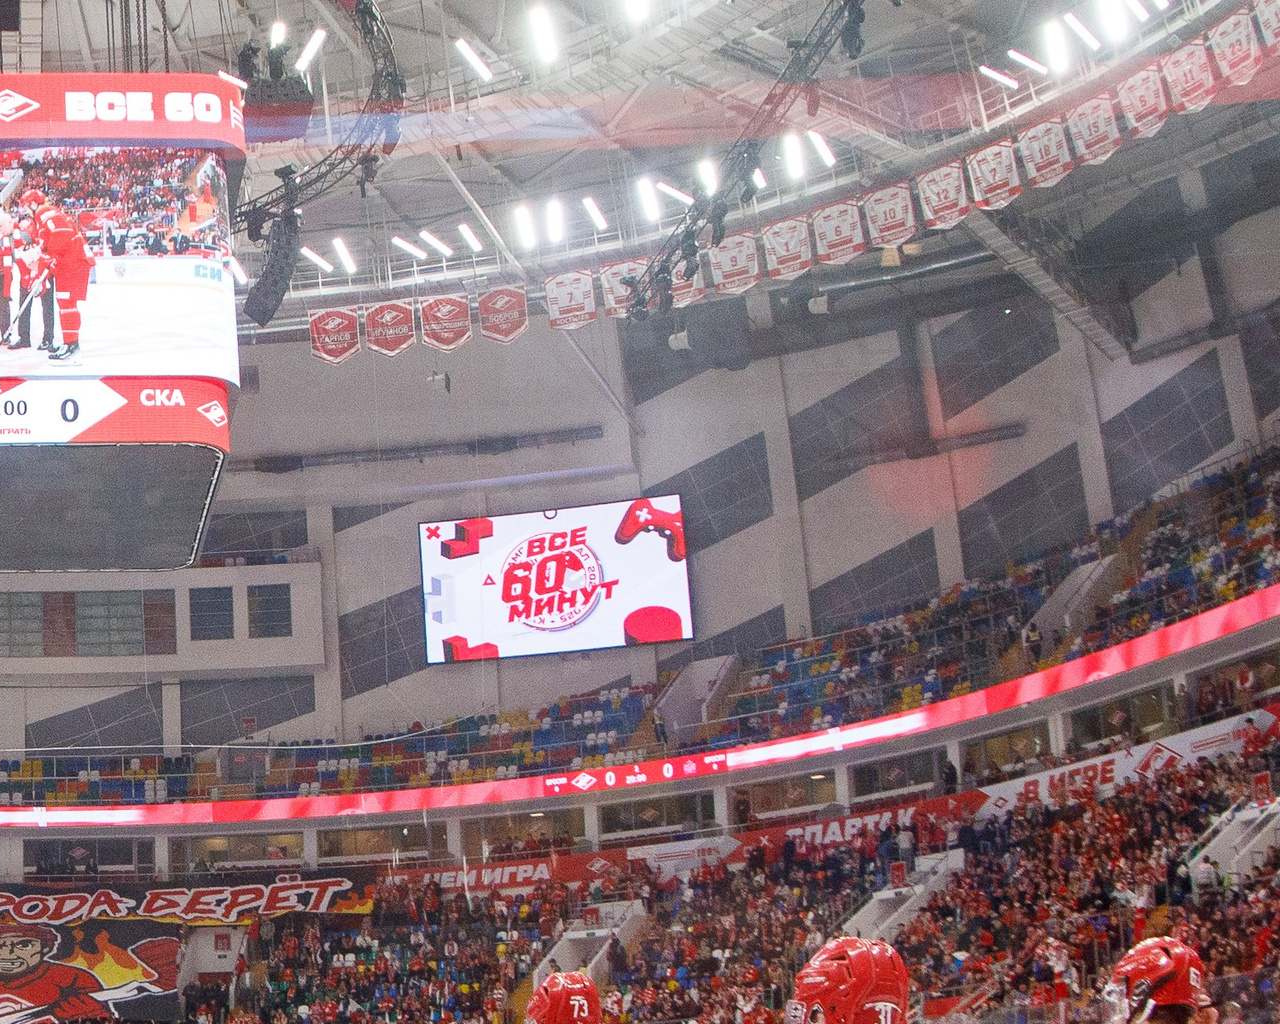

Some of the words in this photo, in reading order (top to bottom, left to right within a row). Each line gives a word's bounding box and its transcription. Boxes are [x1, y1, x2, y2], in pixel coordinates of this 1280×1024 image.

[64, 91, 153, 121] ВСЕ
[163, 91, 223, 121] 60
[883, 207, 896, 222] 10
[139, 389, 185, 407] СКА
[61, 399, 80, 422] 0
[526, 526, 588, 557] ВСЕ
[501, 551, 568, 604] 60
[508, 579, 619, 623] МИНУТ
[605, 771, 616, 786] 0
[662, 763, 674, 778] 0
[484, 862, 551, 885] ИГРА
[138, 874, 353, 923] БЕРЁТ
[570, 996, 589, 1019] 73
